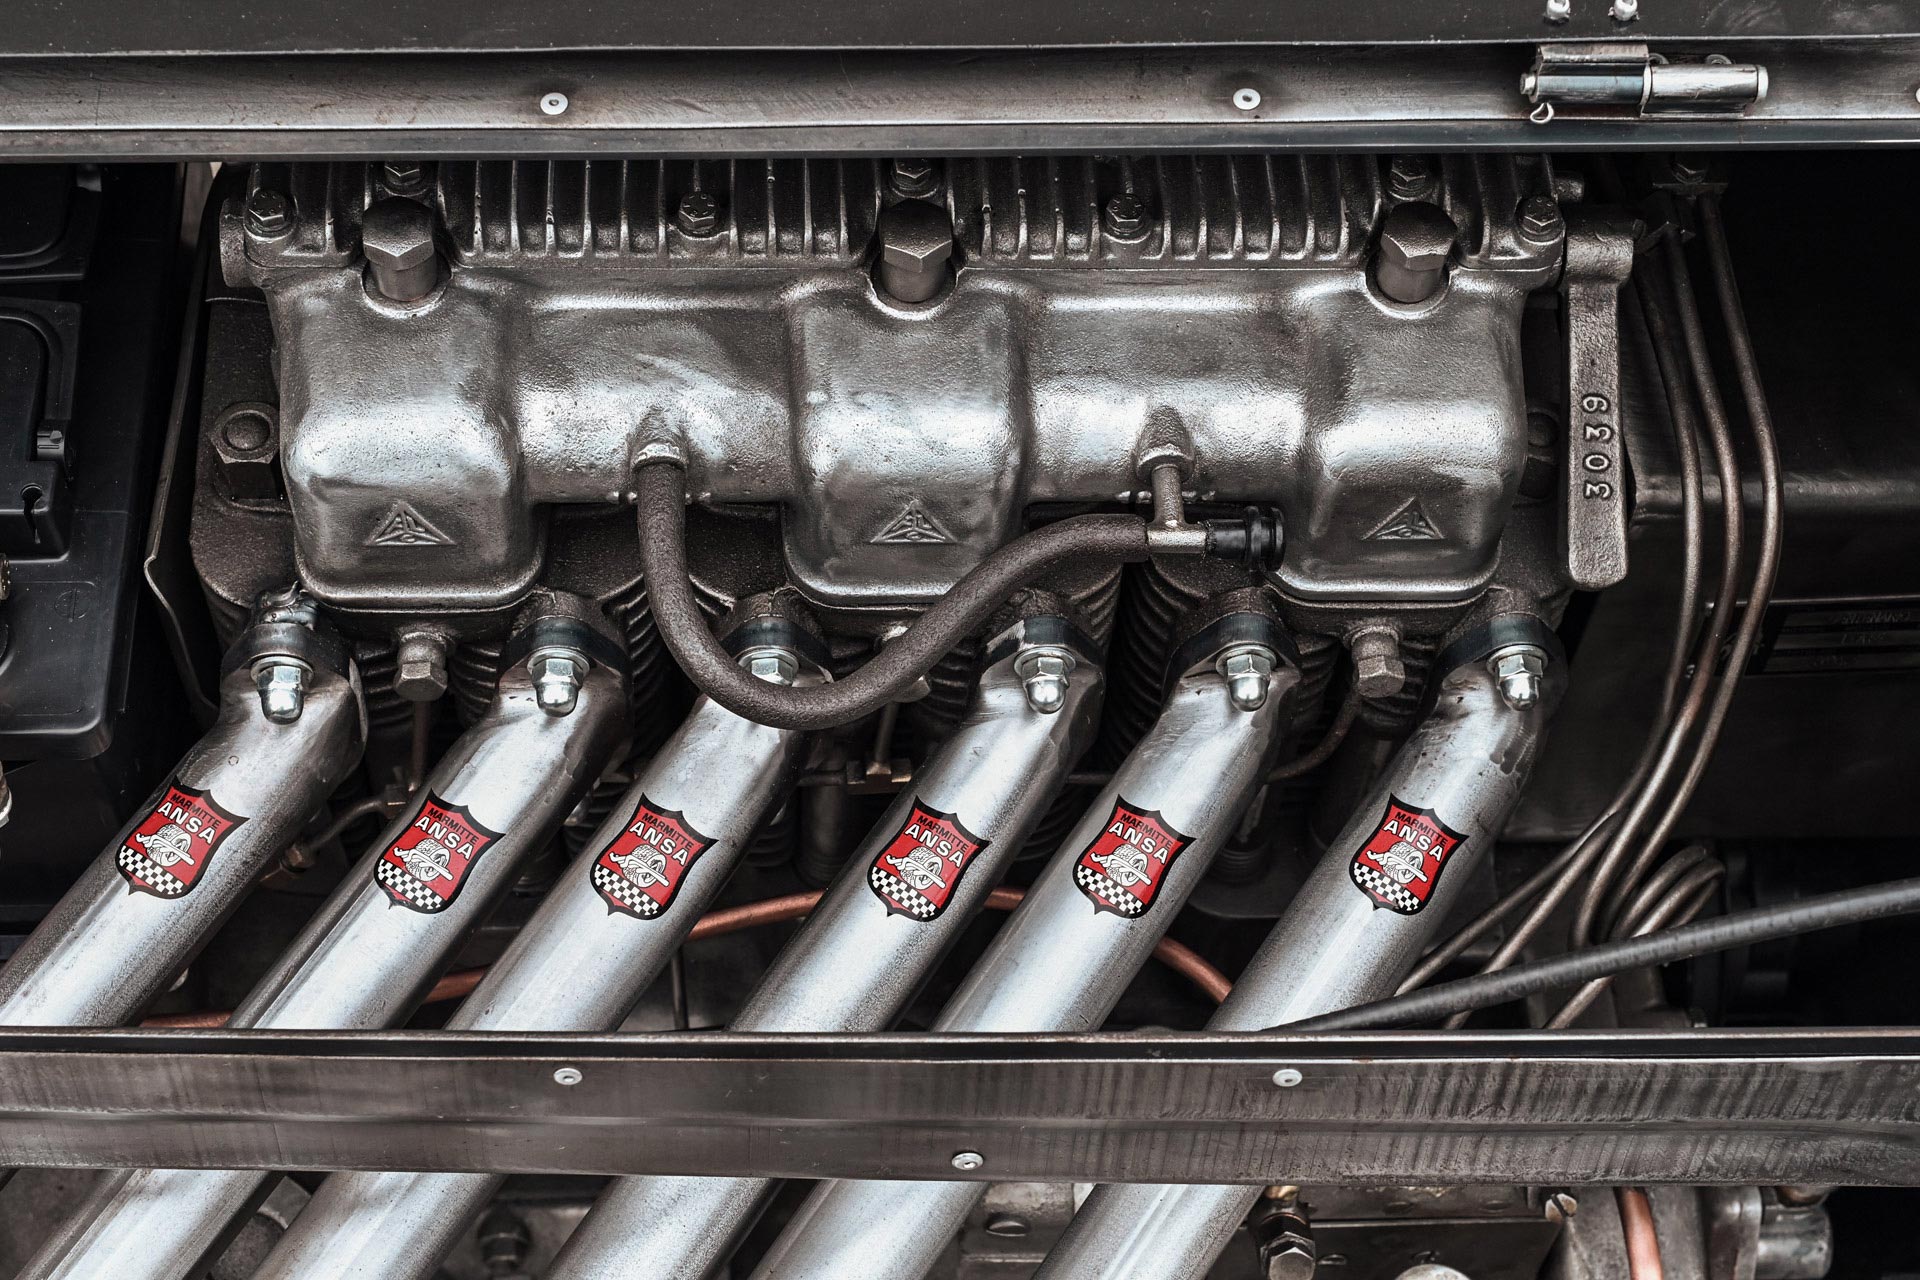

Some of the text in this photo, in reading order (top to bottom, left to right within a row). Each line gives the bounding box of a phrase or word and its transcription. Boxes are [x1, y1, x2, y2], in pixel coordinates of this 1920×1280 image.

[1582, 395, 1612, 498] 3039
[158, 801, 216, 844] ANSA
[170, 793, 221, 829] MARMITTE
[428, 808, 479, 844] MARMITTE
[642, 813, 694, 850] MARMITTE
[1120, 813, 1173, 849] MARMITTE
[1395, 812, 1448, 848] MARMITTE
[415, 816, 474, 860] ANSA
[629, 821, 689, 866] ANSA
[905, 824, 965, 868] ANSA
[917, 815, 969, 853] MARMITTE
[1108, 821, 1168, 864] ANSA
[1383, 819, 1444, 861] ANSA
